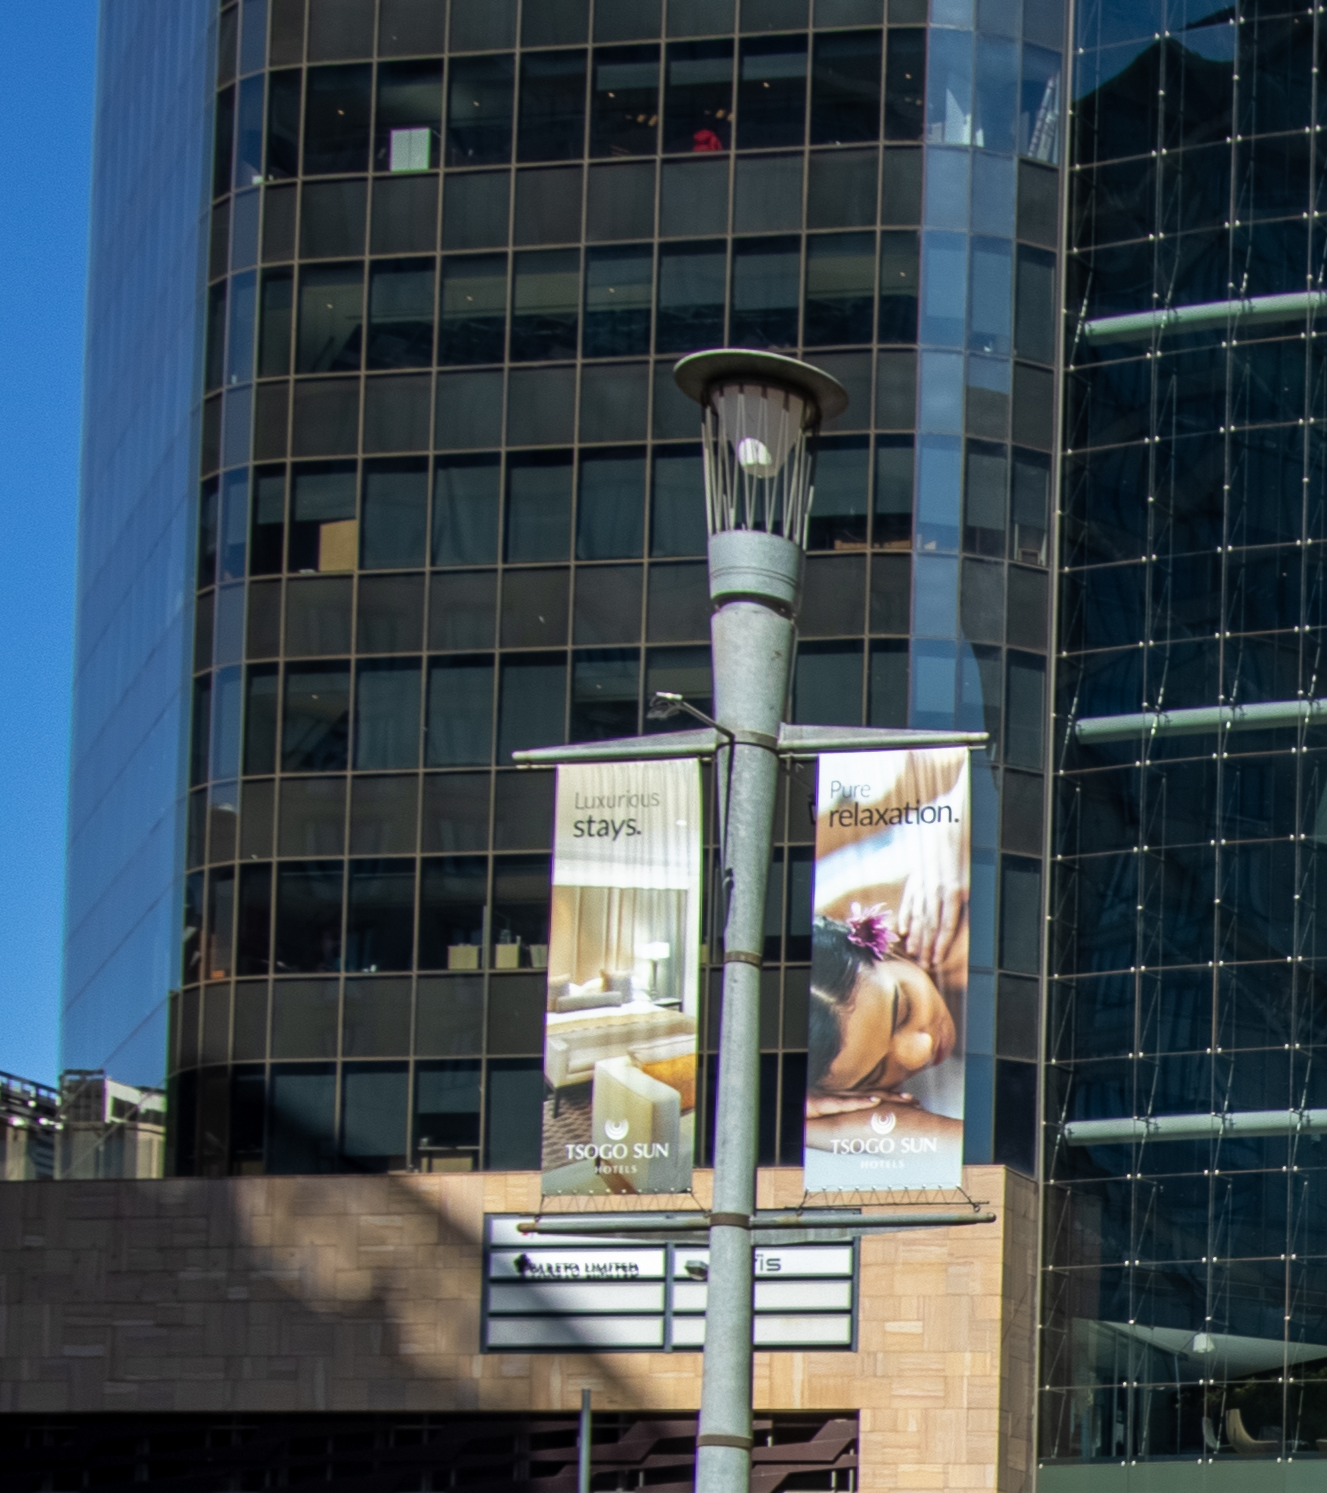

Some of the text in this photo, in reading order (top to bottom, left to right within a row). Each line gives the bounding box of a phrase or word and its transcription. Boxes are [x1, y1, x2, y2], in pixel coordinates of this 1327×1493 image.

[830, 779, 872, 799] Pure
[574, 790, 661, 810] Luxurious
[828, 799, 960, 828] relaxation.
[572, 814, 642, 842] stays.
[564, 1142, 670, 1160] TSOGO SUN
[829, 1136, 938, 1155] TSOGO SUN
[595, 1164, 638, 1175] HOTELS
[860, 1159, 905, 1169] HOTELS
[584, 1262, 640, 1274] LIMITED
